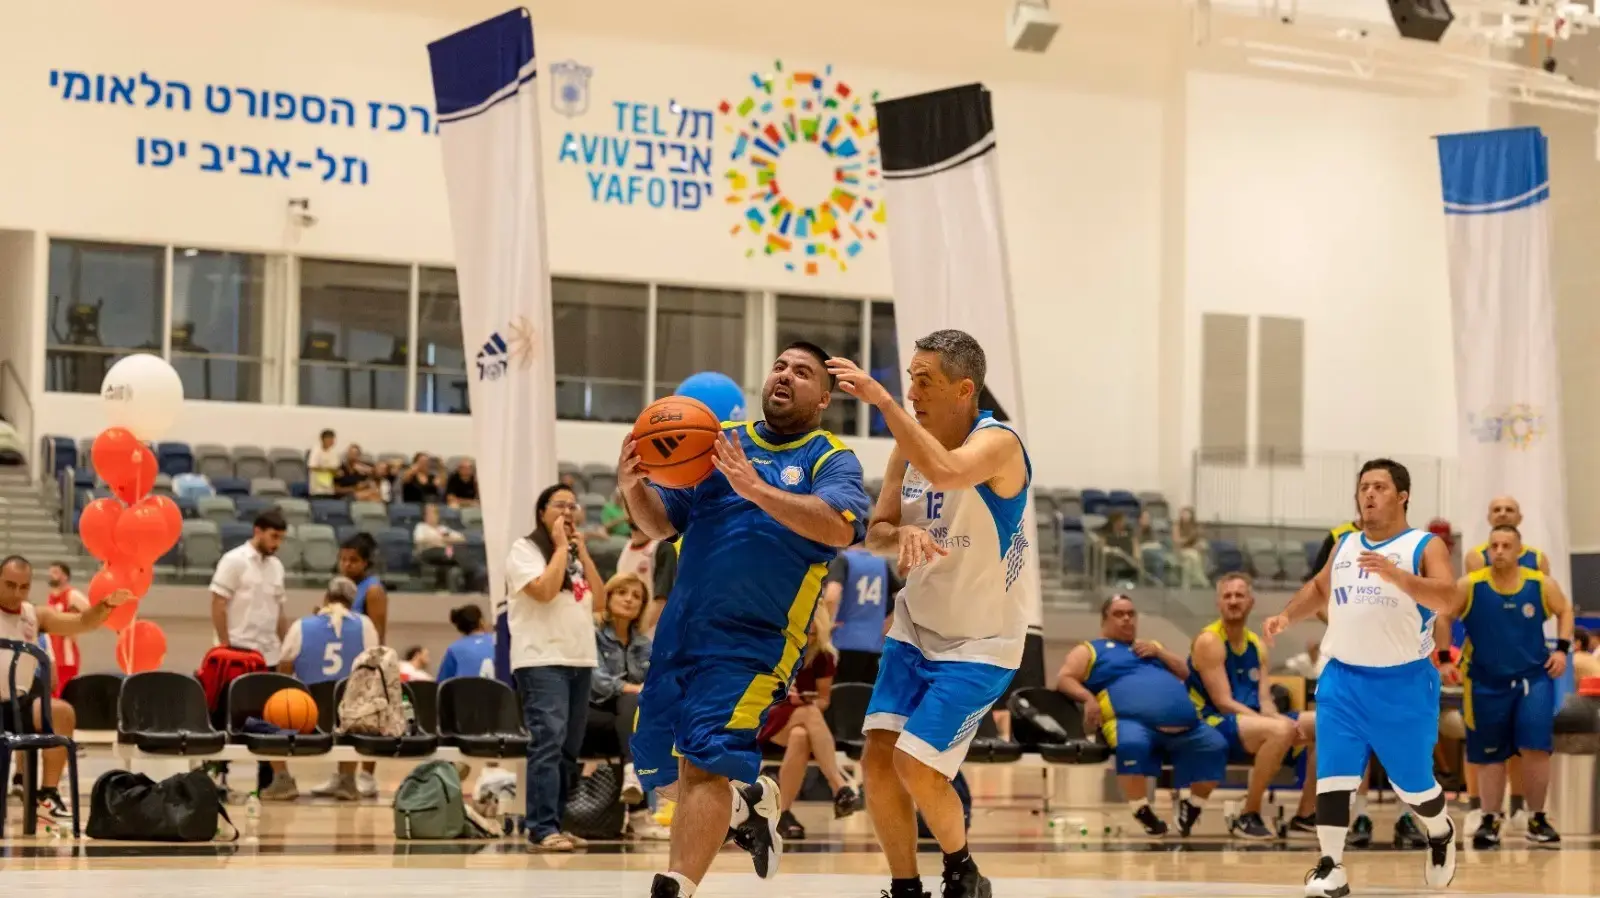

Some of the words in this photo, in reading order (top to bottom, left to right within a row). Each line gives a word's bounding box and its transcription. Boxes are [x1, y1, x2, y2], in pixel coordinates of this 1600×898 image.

[48, 70, 191, 111] הלאומי
[205, 84, 355, 127] הספורט
[367, 101, 439, 135] רכז
[612, 100, 667, 136] TEL
[668, 98, 714, 140] תל
[136, 137, 187, 167] יפו
[558, 132, 630, 167] AVIV
[635, 140, 712, 176] אביב
[587, 171, 666, 208] YAFO
[670, 179, 712, 210] יפו
[926, 491, 944, 520] 12
[855, 575, 882, 606] 14
[1353, 594, 1399, 608] SPORTS
[1356, 585, 1382, 596] WSC
[322, 642, 344, 676] 5
